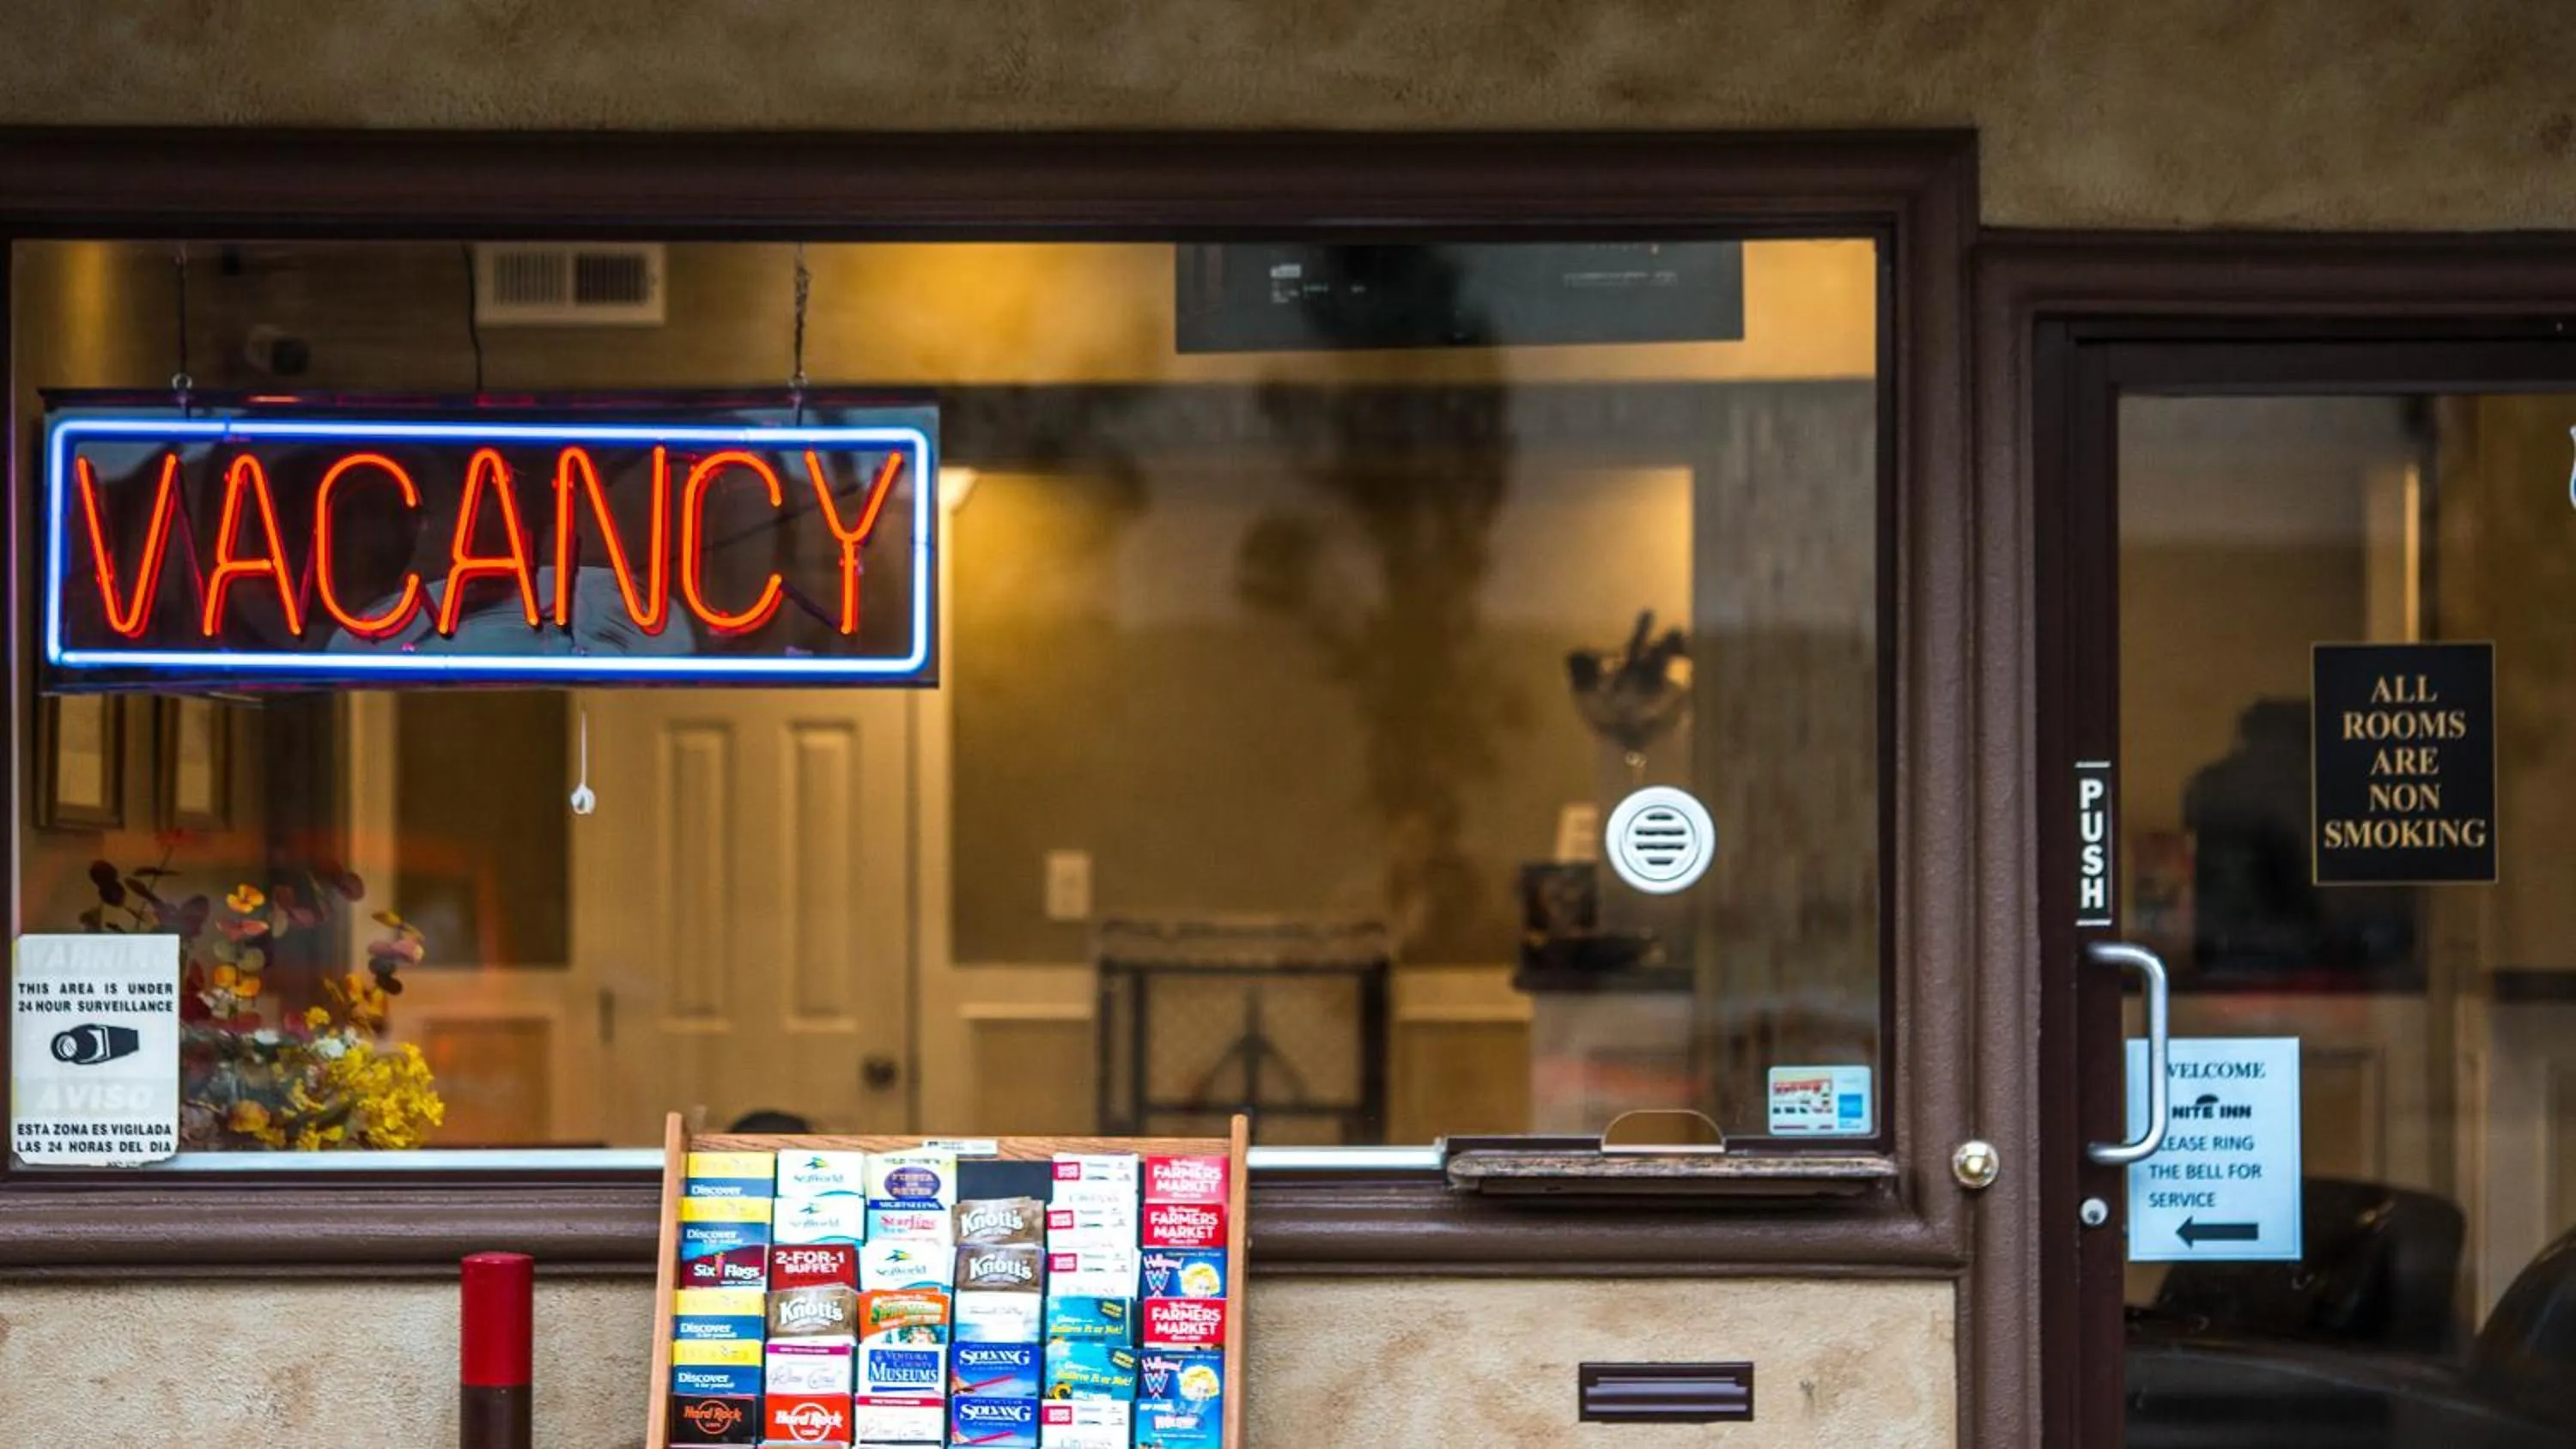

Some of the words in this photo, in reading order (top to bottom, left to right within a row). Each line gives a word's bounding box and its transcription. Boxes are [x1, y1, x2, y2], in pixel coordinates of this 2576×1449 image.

[76, 446, 902, 636] VACANCY
[2371, 675, 2438, 703] ALL
[2342, 711, 2466, 741] ROOMS
[2370, 747, 2439, 775] ARE
[2369, 783, 2441, 812] NON
[2324, 819, 2488, 849] SMOKING
[2079, 778, 2105, 909] PUSH
[18, 983, 49, 995] THIS
[59, 983, 94, 995] AREA
[105, 983, 118, 995] IS
[128, 983, 173, 995] UNDER
[18, 1001, 33, 1012] 24
[35, 1001, 71, 1012] HOUR
[78, 1001, 173, 1012] SURVEILLANCE
[2172, 1105, 2215, 1119] NITE
[2220, 1105, 2251, 1119] INN
[17, 1124, 50, 1136] ESTA
[52, 1124, 87, 1136] ZONA
[92, 1124, 107, 1136] ES
[111, 1124, 171, 1136] VIGILADA
[17, 1141, 41, 1153] LAS
[48, 1141, 62, 1153] 24
[69, 1141, 112, 1153] HORAS
[119, 1141, 143, 1153] DEL
[150, 1141, 171, 1153] DIA
[2158, 1136, 2207, 1151] EASE
[2213, 1136, 2254, 1151] RING
[1153, 1165, 1223, 1180] FARMERS
[2150, 1164, 2180, 1179] THE
[2186, 1164, 2223, 1179] BELL
[2227, 1164, 2262, 1179] FOR
[692, 1185, 743, 1196] Discover
[1156, 1179, 1218, 1192] MARKET
[2148, 1192, 2215, 1208] SERVICE
[961, 1208, 1024, 1236] Knott's
[1151, 1212, 1218, 1226] FARMERS
[687, 1229, 737, 1240] Discover
[1153, 1225, 1215, 1239] MARKET
[775, 1251, 845, 1264] 2-FOR-1
[694, 1264, 715, 1276] Six
[725, 1264, 760, 1279] Flags
[785, 1263, 839, 1274] BUFFET
[970, 1253, 1032, 1280] Knott's
[781, 1295, 843, 1324] Knott's
[1151, 1307, 1221, 1322] FARMERS
[680, 1322, 732, 1333] Discover
[1154, 1321, 1218, 1335] MARKET
[886, 1351, 927, 1361] VENTURA
[678, 1372, 729, 1383] Discover
[870, 1361, 937, 1382] MUSEUMS
[683, 1405, 712, 1419] Hard
[714, 1407, 742, 1422] Rock
[776, 1410, 811, 1425] Hard
[811, 1412, 842, 1428] Rock
